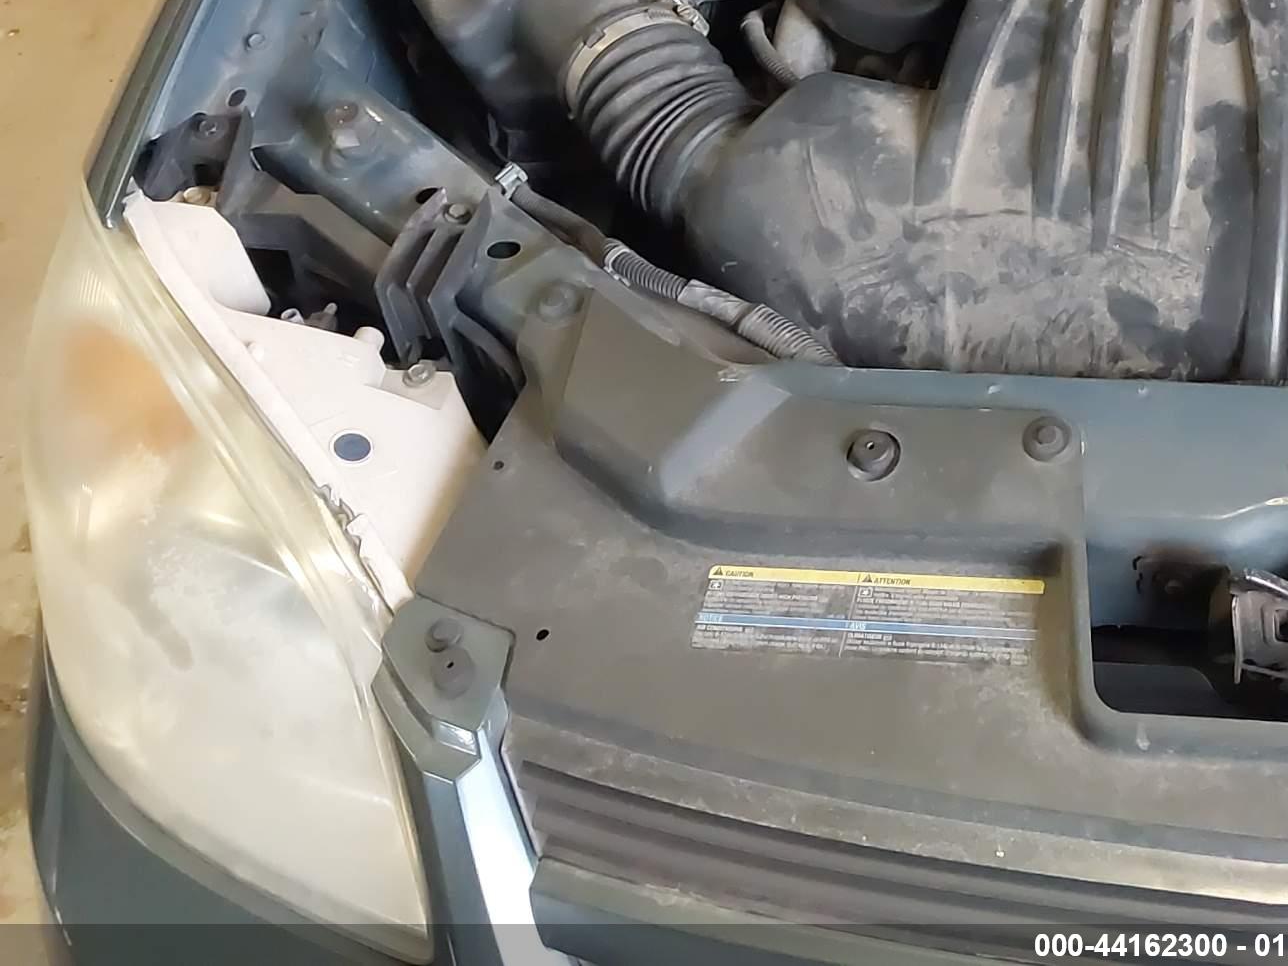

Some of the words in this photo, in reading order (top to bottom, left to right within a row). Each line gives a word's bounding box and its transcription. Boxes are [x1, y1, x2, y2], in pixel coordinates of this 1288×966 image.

[725, 570, 754, 578] CAUTION
[872, 577, 911, 586] ATTENTION
[849, 622, 867, 631] AVIS
